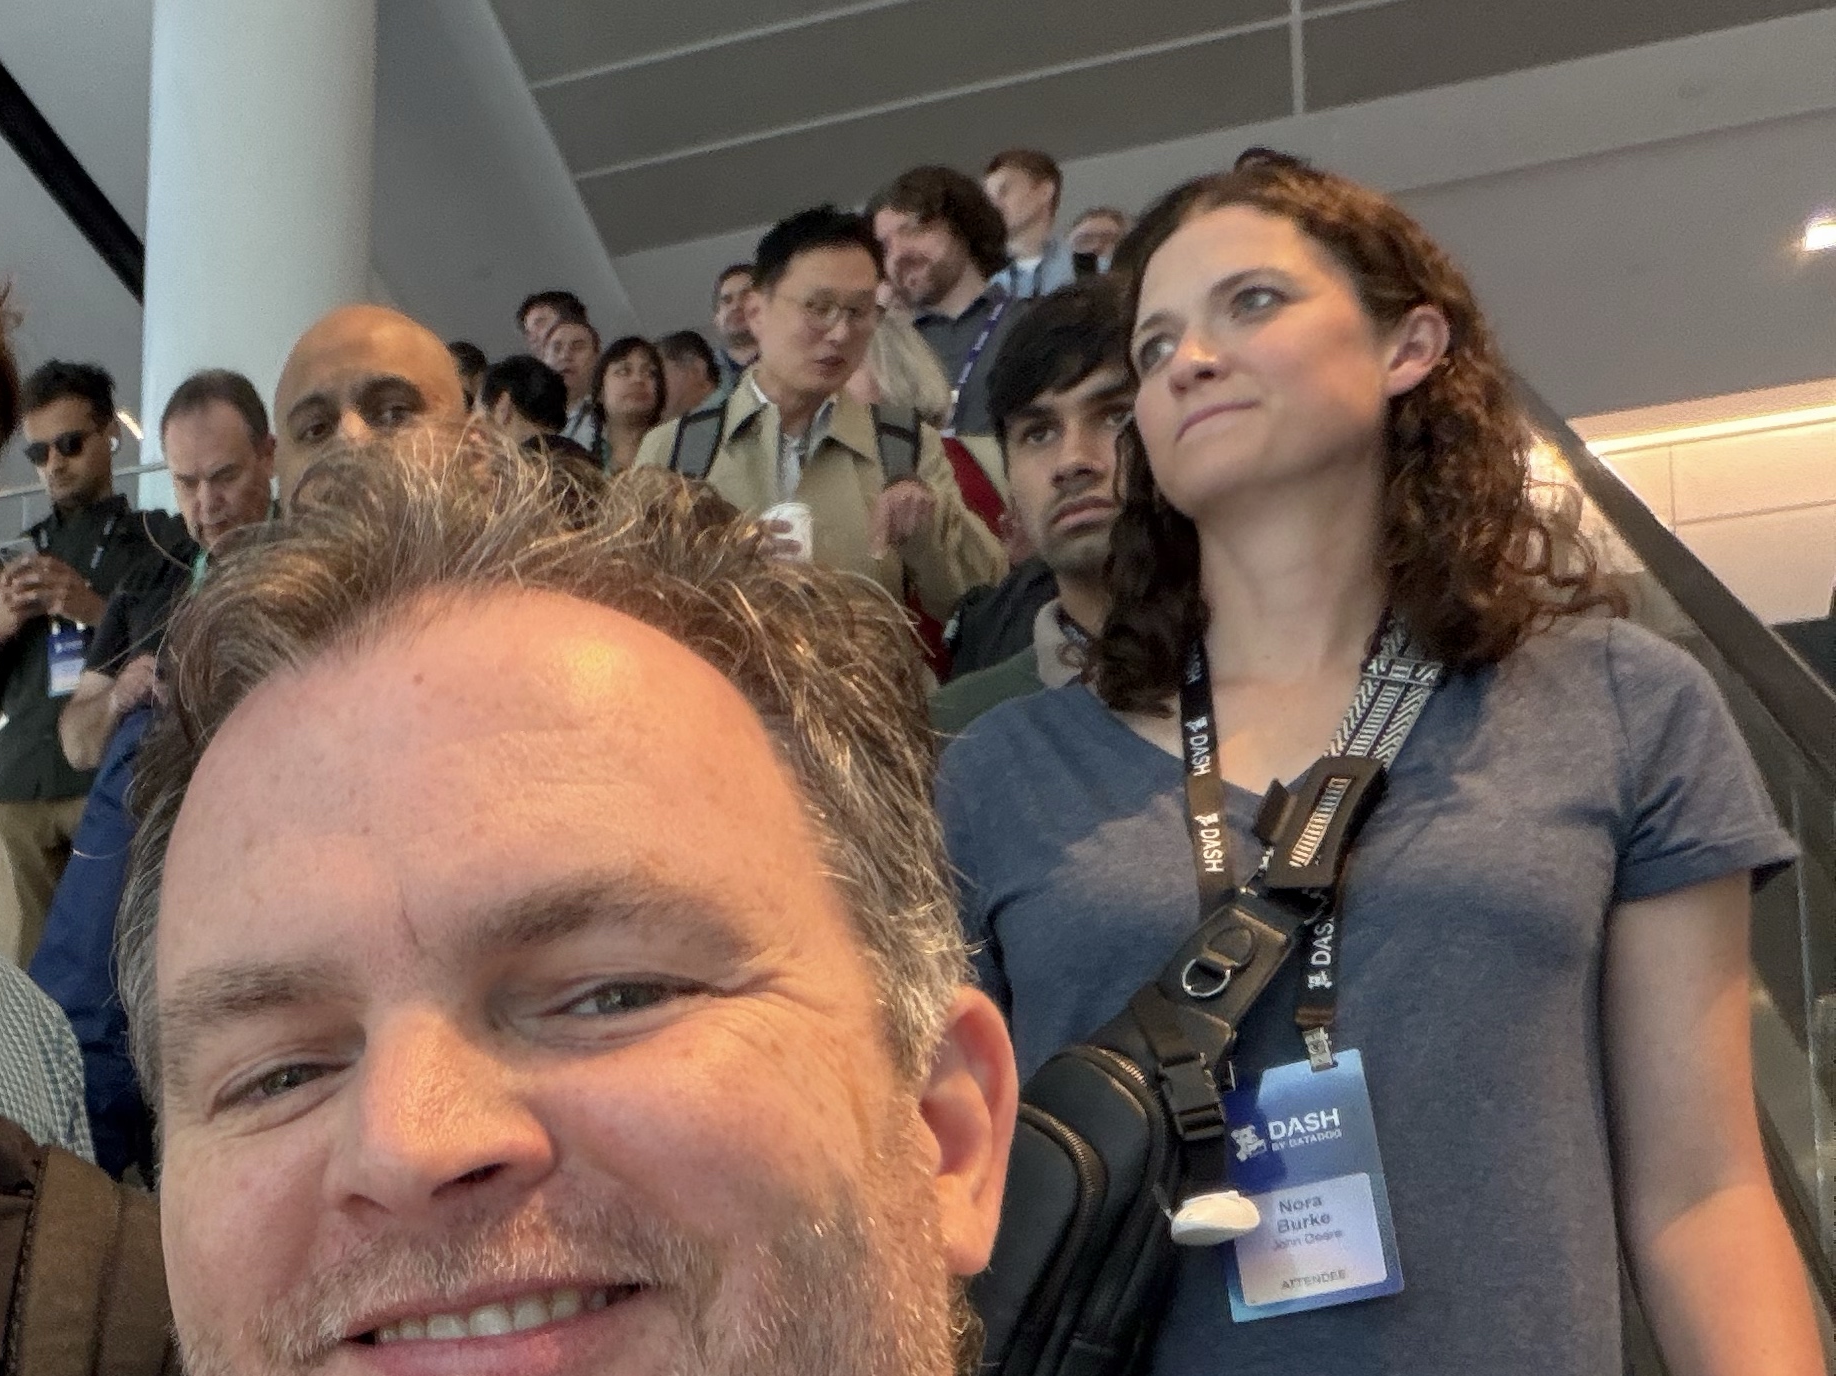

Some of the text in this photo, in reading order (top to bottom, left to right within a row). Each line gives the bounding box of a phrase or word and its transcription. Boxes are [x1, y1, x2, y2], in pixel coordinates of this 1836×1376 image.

[1189, 734, 1210, 777] DASH
[1199, 827, 1224, 873] DASH
[1311, 917, 1334, 966] DAS
[1269, 1108, 1340, 1140] DASH
[1278, 1196, 1323, 1215] Nora
[1277, 1213, 1331, 1234] Burke
[1281, 1269, 1346, 1290] ATTENDEE
